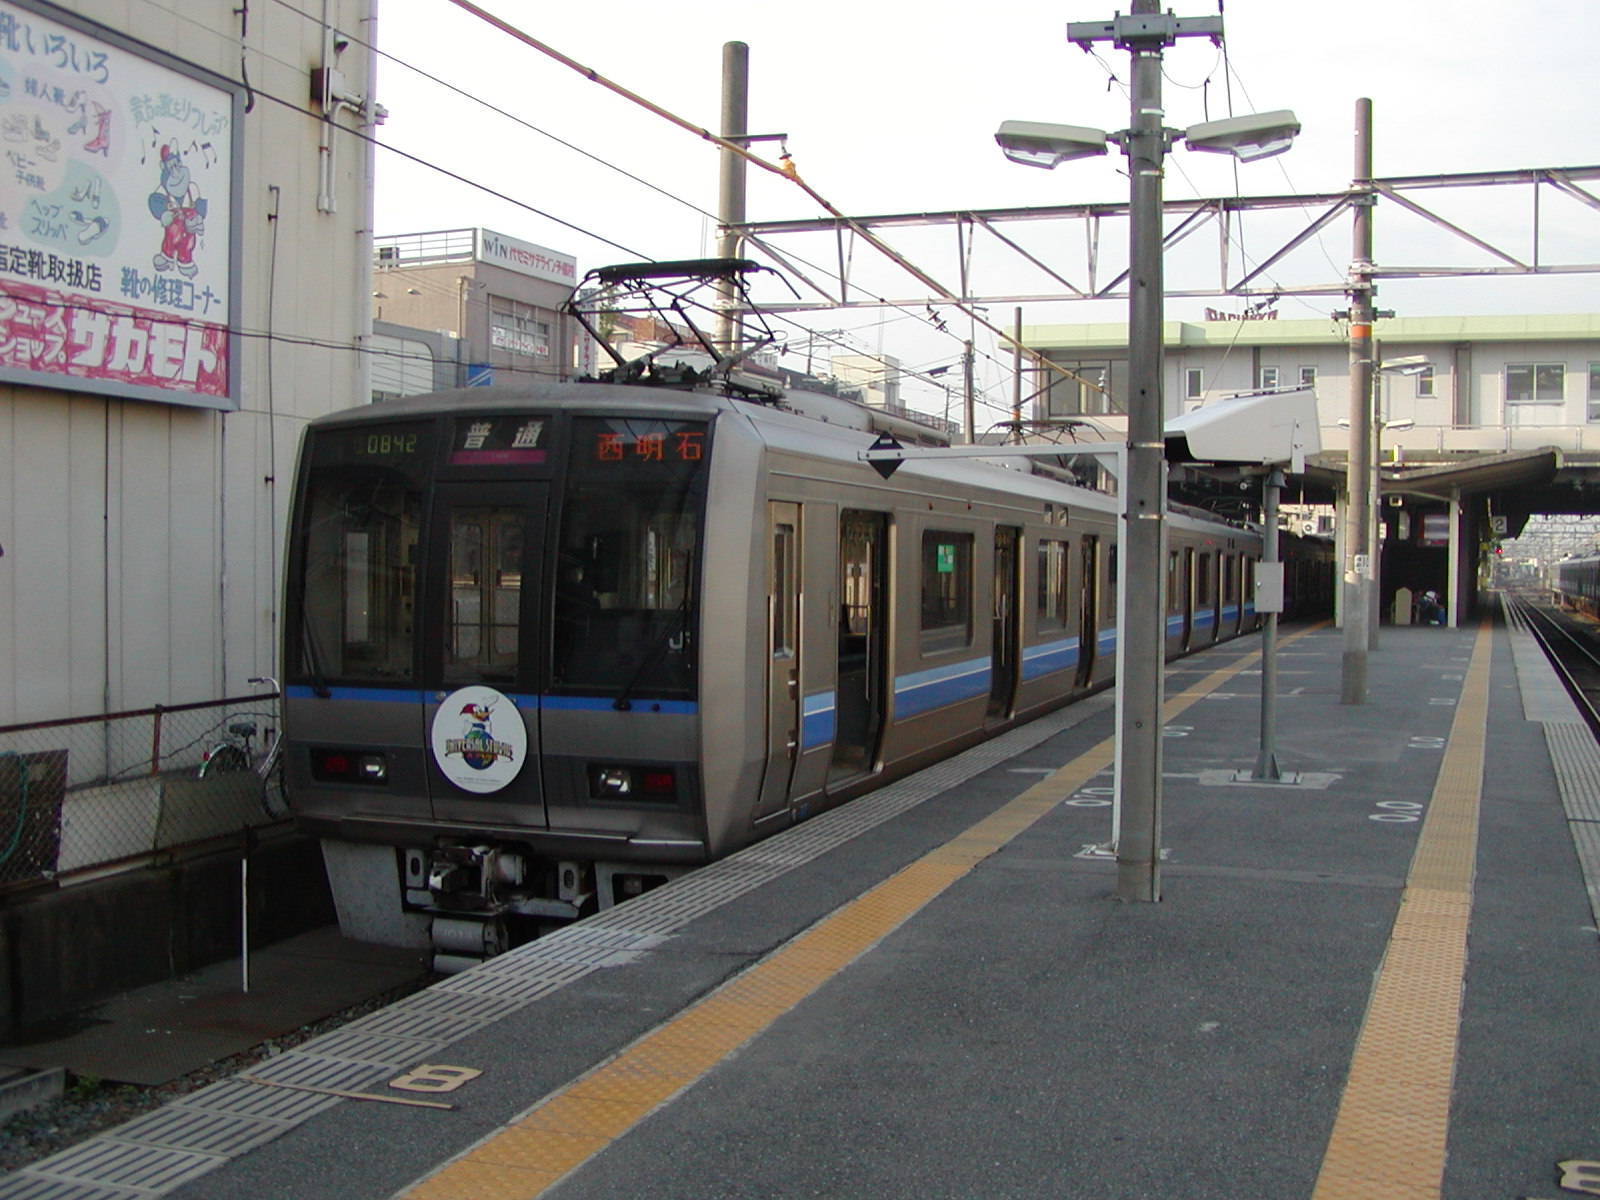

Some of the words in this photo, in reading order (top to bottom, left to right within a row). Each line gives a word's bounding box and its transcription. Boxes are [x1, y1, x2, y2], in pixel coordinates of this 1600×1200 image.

[70, 302, 218, 382] サカモト
[367, 433, 417, 454] 0842
[463, 421, 545, 449] 普通
[596, 432, 705, 461] 西明石
[1495, 519, 1504, 532] 2
